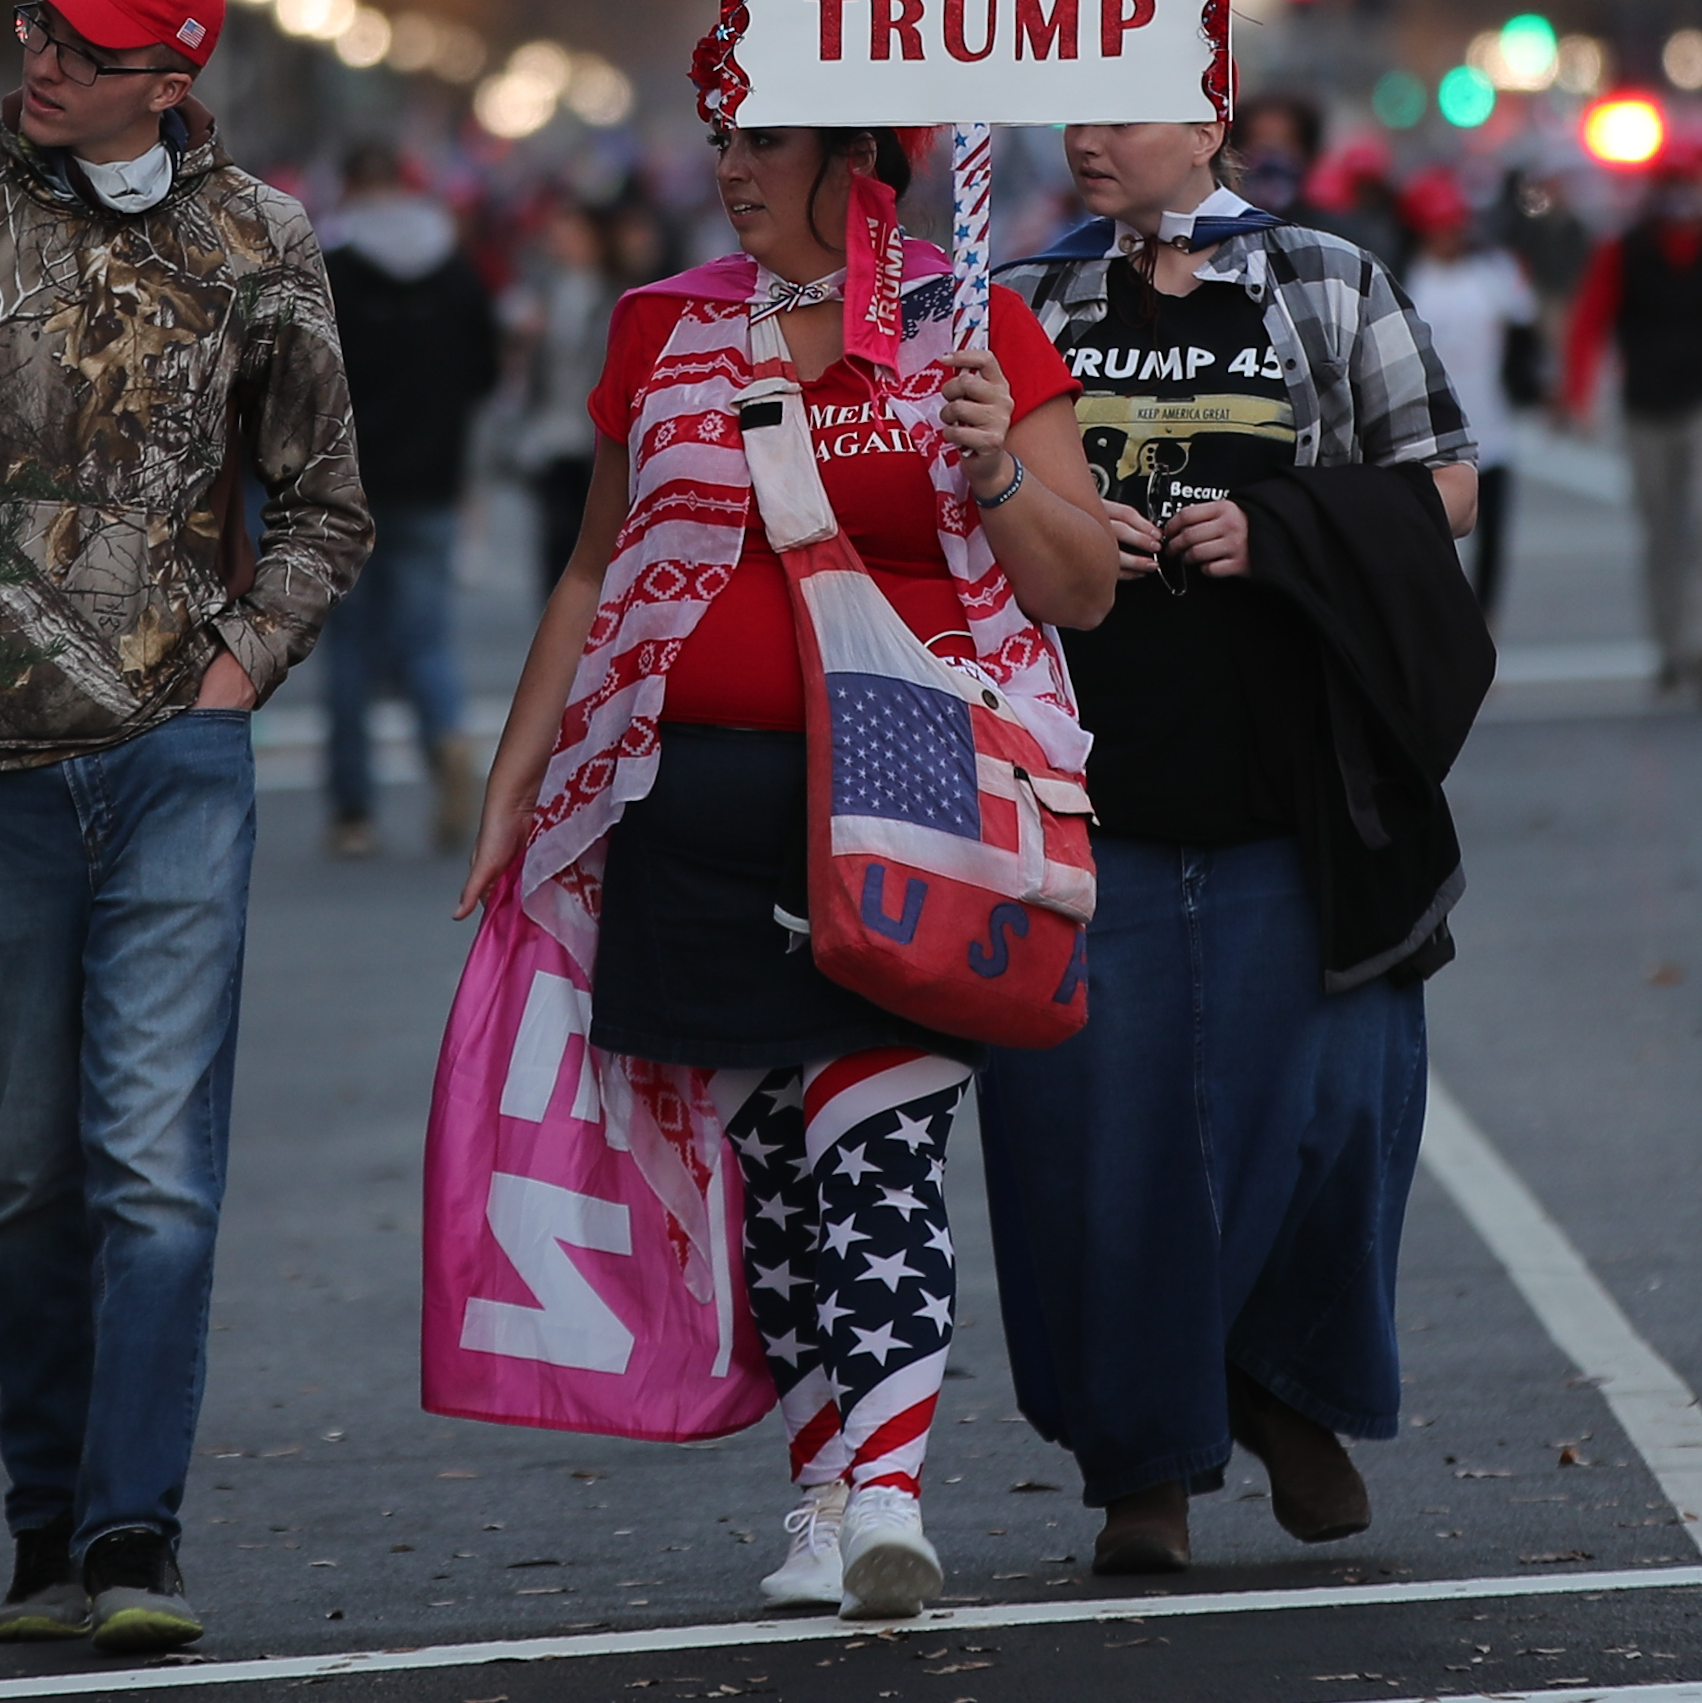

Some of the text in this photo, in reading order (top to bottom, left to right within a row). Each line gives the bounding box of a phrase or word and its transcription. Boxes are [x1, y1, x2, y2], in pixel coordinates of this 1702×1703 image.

[1137, 408, 1230, 420] KEEP AMERICA GREAT
